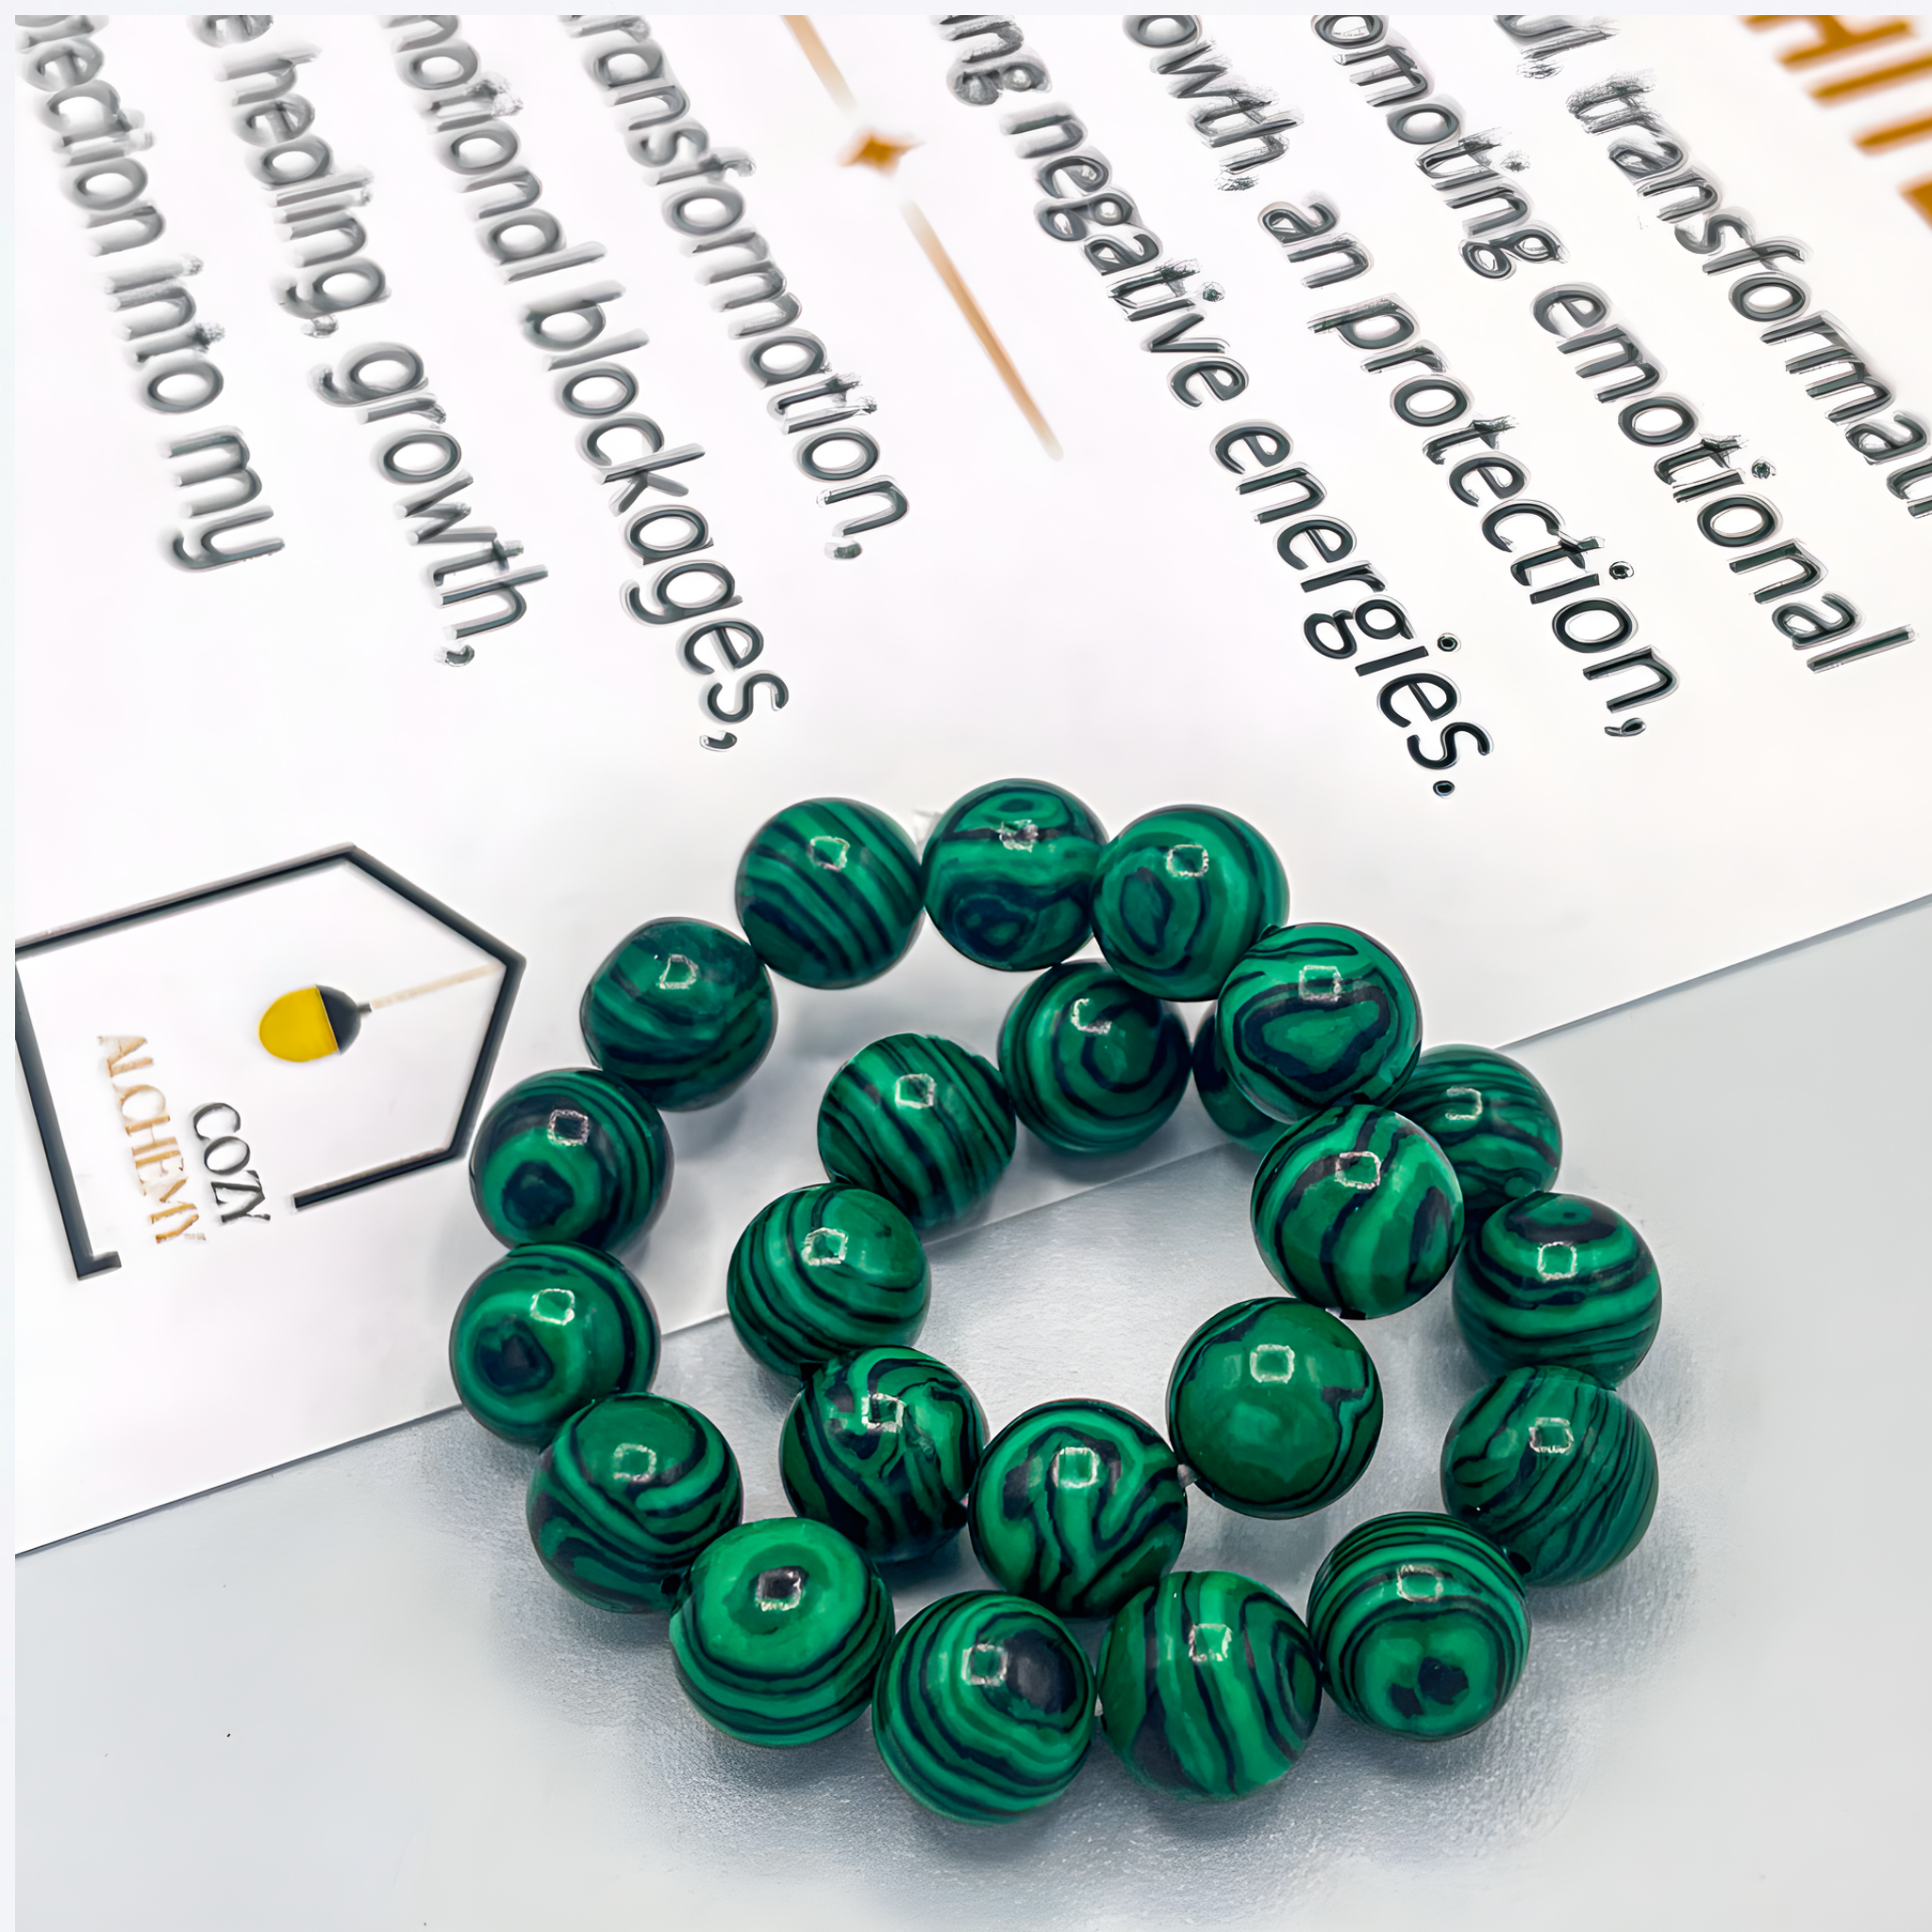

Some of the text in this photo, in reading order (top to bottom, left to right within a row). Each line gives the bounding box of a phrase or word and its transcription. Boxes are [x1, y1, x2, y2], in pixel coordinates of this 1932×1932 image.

[15, 15, 285, 573] tection into my
[214, 43, 391, 338] healing,
[308, 341, 548, 667] growth,
[555, 15, 909, 559] ransformation,
[999, 101, 1249, 409] negative
[1209, 418, 1494, 798] energies.
[1257, 191, 1374, 290] an
[1566, 69, 1932, 518] transforma
[517, 280, 789, 752] blockages,
[1307, 292, 1680, 738] protection,
[1530, 283, 1919, 673] emotional
[97, 1035, 205, 1243] ALCHEMY
[192, 1102, 271, 1224] COZY
